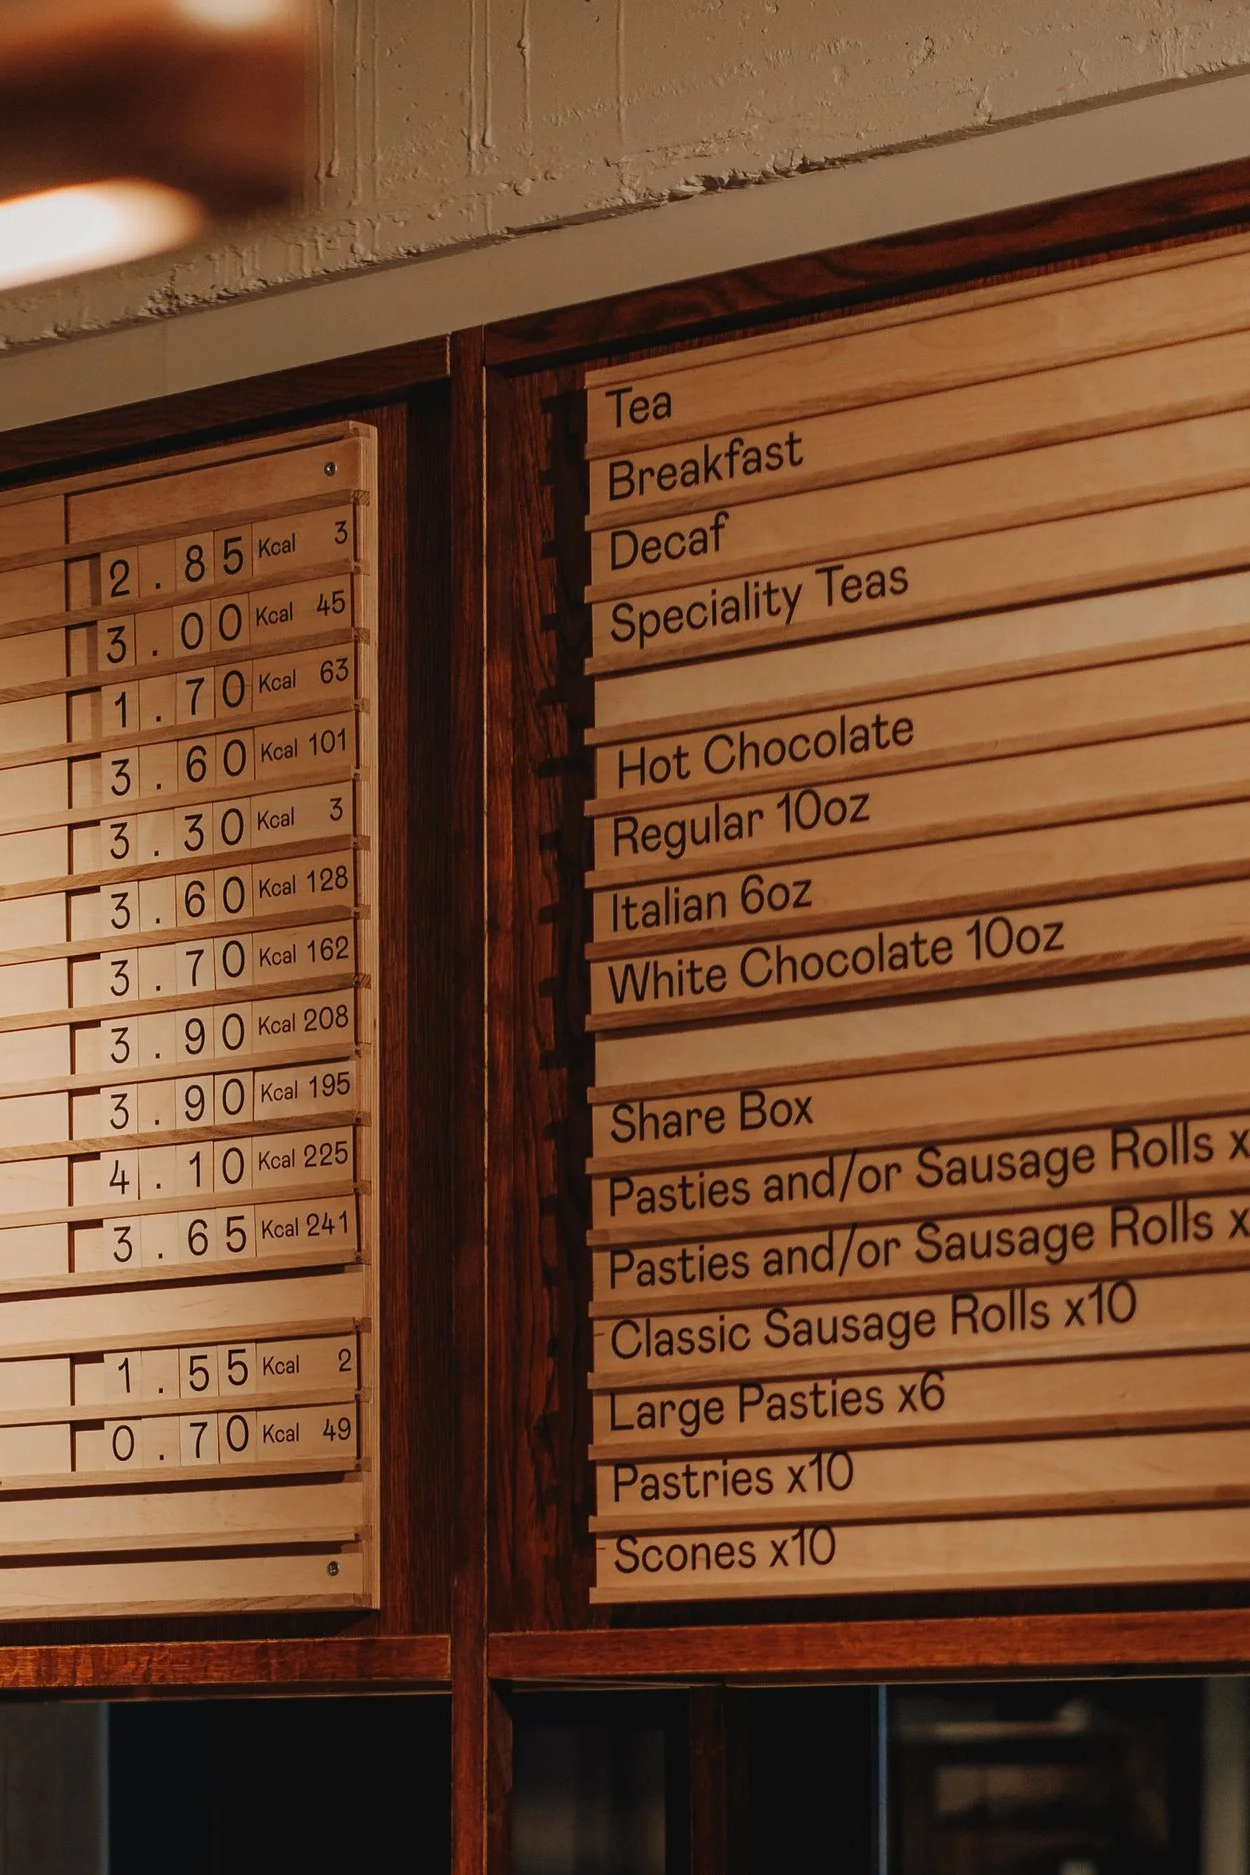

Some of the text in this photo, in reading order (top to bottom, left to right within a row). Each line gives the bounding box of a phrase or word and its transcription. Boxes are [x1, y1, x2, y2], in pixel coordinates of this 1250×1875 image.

[605, 387, 672, 429] Tea
[609, 431, 803, 500] Breakfast
[258, 533, 296, 558] Kcal
[334, 520, 348, 545] 3
[611, 512, 729, 571] Decaf
[256, 601, 293, 626] Kcal
[317, 590, 346, 616] 45
[611, 564, 908, 649] Speciality Teas
[259, 669, 296, 692] Kcal
[320, 657, 349, 684] 63
[261, 739, 298, 761] Kcal
[308, 728, 347, 755] 101
[618, 715, 914, 789] Hot Chocolate
[257, 807, 295, 830] Kcal
[330, 798, 343, 821] 3
[614, 788, 870, 859] Regular 10oz
[258, 877, 296, 898] Kcal
[307, 865, 348, 891] 128
[611, 876, 812, 932] Italian 6oz
[259, 945, 296, 967] Kcal
[307, 936, 349, 962] 162
[608, 917, 1065, 1004] White Chocolate 10oz
[258, 1014, 295, 1036] Kcal
[304, 1004, 349, 1032] 208
[261, 1081, 298, 1103] Kcal
[309, 1072, 350, 1098] 195
[611, 1091, 814, 1144] Share Box
[258, 1149, 295, 1171] Kcal
[304, 1141, 348, 1168] 225
[610, 1173, 750, 1217] Pasties
[763, 1148, 901, 1203] and/or
[916, 1142, 1095, 1189] Sausage
[1111, 1121, 1214, 1170] Rolls
[262, 1217, 298, 1239] Kcal
[307, 1211, 348, 1236] 241
[610, 1246, 750, 1290] Pasties
[763, 1223, 900, 1278] and/or
[915, 1219, 1095, 1266] Sausage
[1111, 1199, 1214, 1249] Rolls
[611, 1280, 1136, 1360] Classic Sausage Rolls x10
[262, 1355, 299, 1376] Kcal
[338, 1348, 351, 1372] 2
[610, 1369, 945, 1437] Large Pasties x6
[263, 1423, 299, 1443] Kcal
[323, 1417, 351, 1440] 49
[614, 1450, 853, 1503] Pastries x10
[614, 1525, 835, 1575] Scones x10
